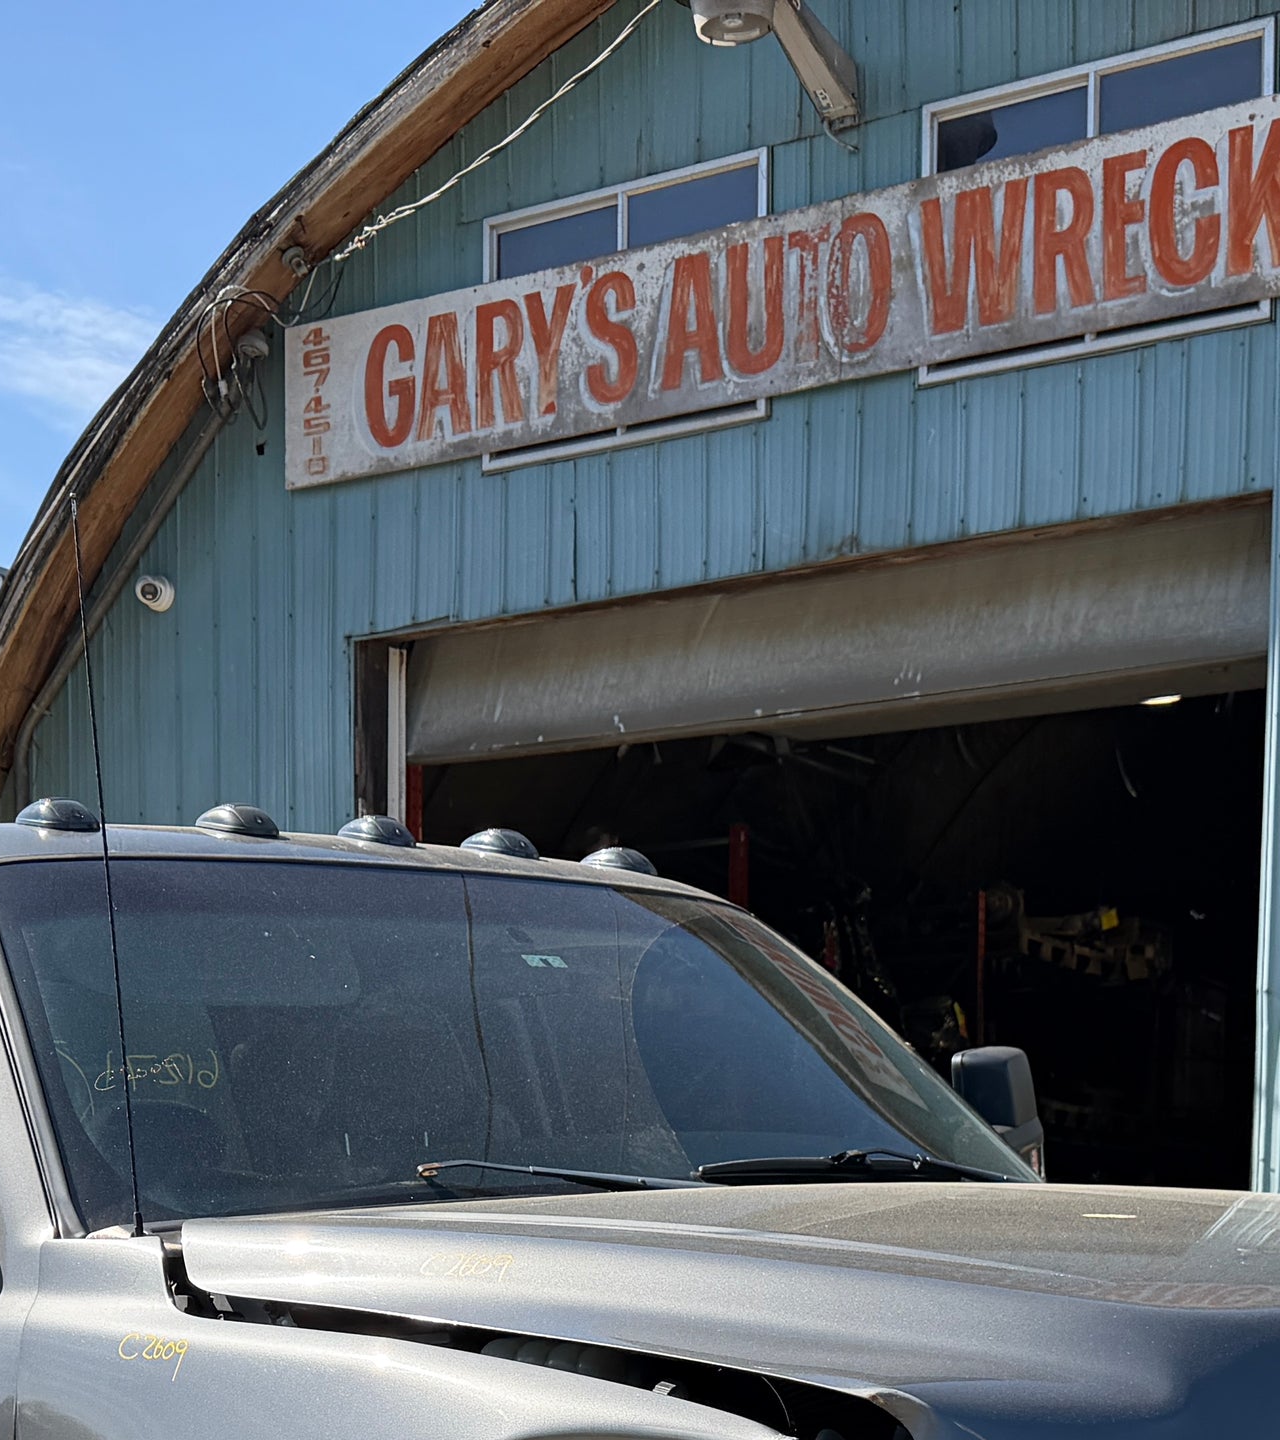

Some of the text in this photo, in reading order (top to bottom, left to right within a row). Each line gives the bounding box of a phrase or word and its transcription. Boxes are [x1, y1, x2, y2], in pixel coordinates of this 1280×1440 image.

[364, 265, 638, 448] GARY'S
[661, 212, 893, 391] AUTO
[118, 1332, 188, 1381] C2609
